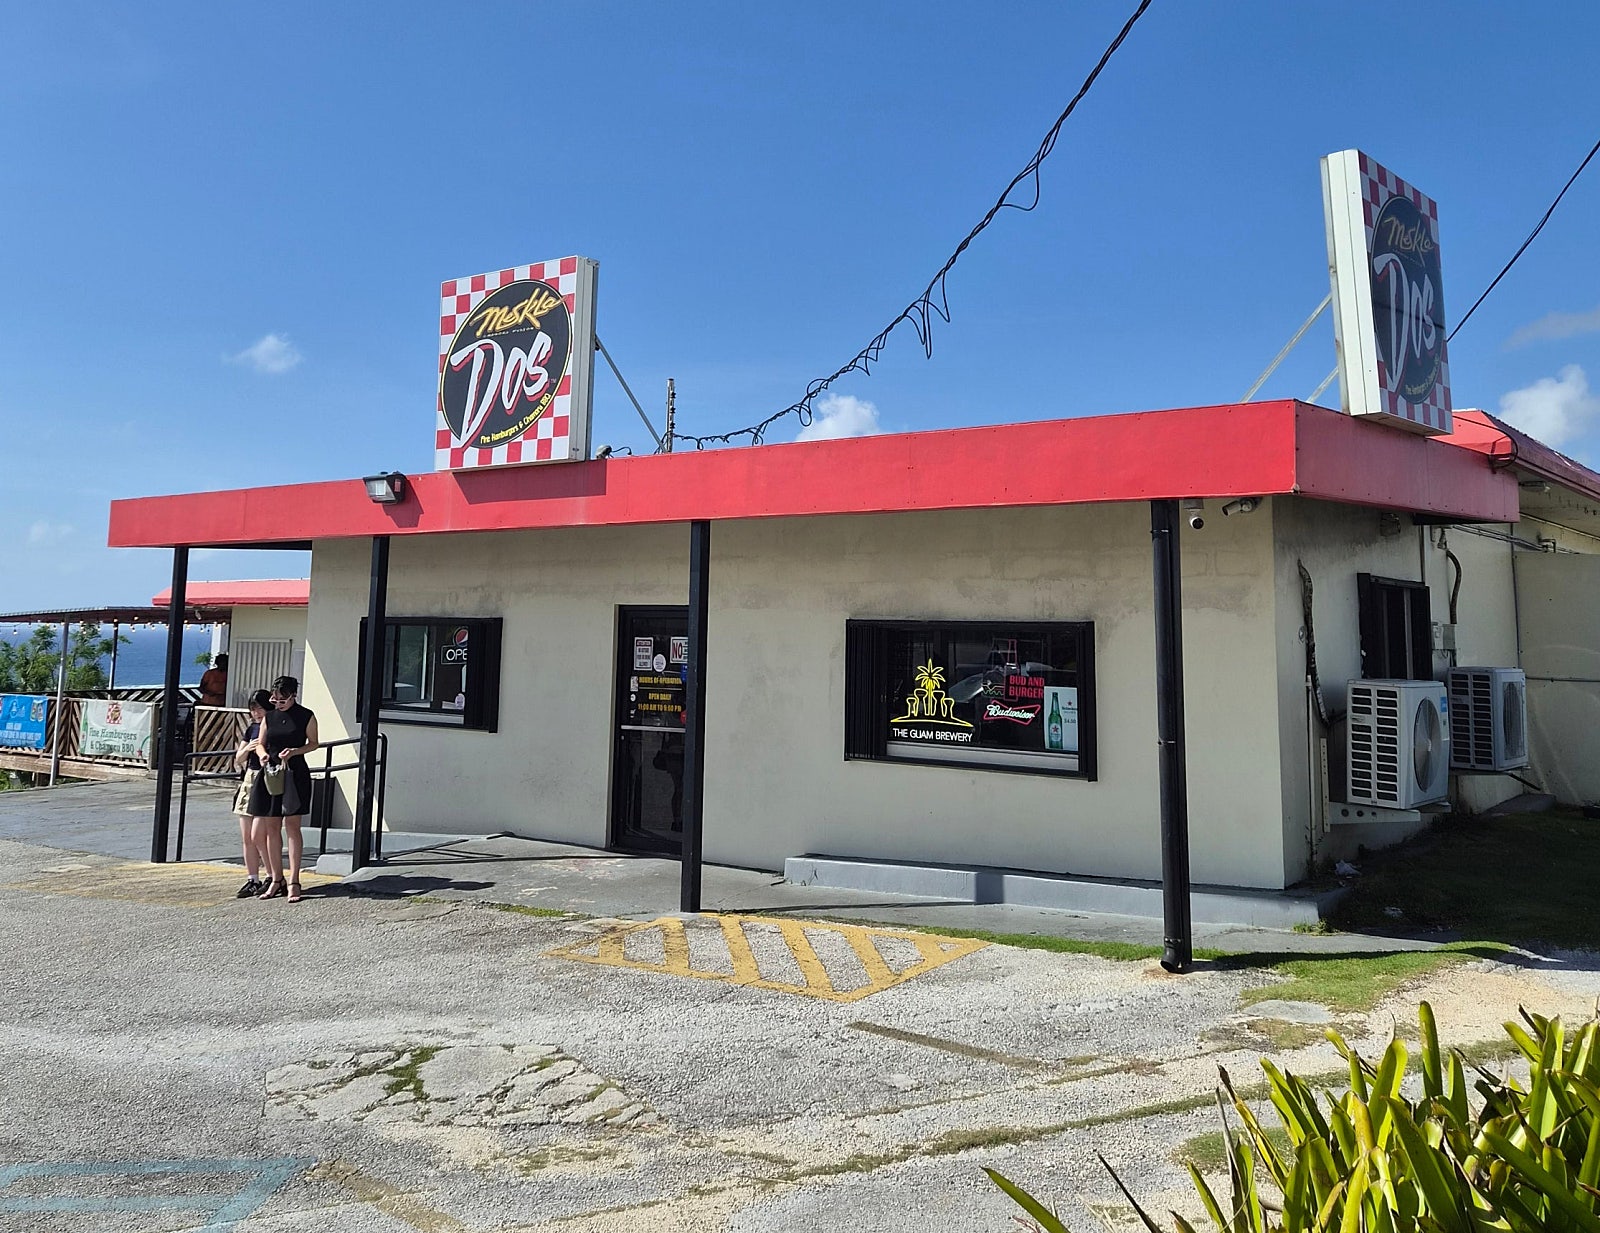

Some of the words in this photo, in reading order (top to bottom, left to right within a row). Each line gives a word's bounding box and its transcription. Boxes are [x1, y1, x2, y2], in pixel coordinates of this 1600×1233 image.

[1383, 217, 1435, 268] Meskla
[469, 287, 565, 338] Meskla
[446, 648, 468, 661] OPE
[672, 642, 683, 659] NO
[1009, 675, 1026, 686] BUD
[1027, 676, 1045, 687] AND
[1009, 686, 1044, 699] BURGER
[986, 704, 1035, 719] Budweiser
[101, 728, 138, 742] Hamburgers
[892, 728, 908, 738] THE
[909, 729, 934, 740] GUAM
[935, 731, 973, 743] BREWERY
[121, 743, 135, 755] BBQ
